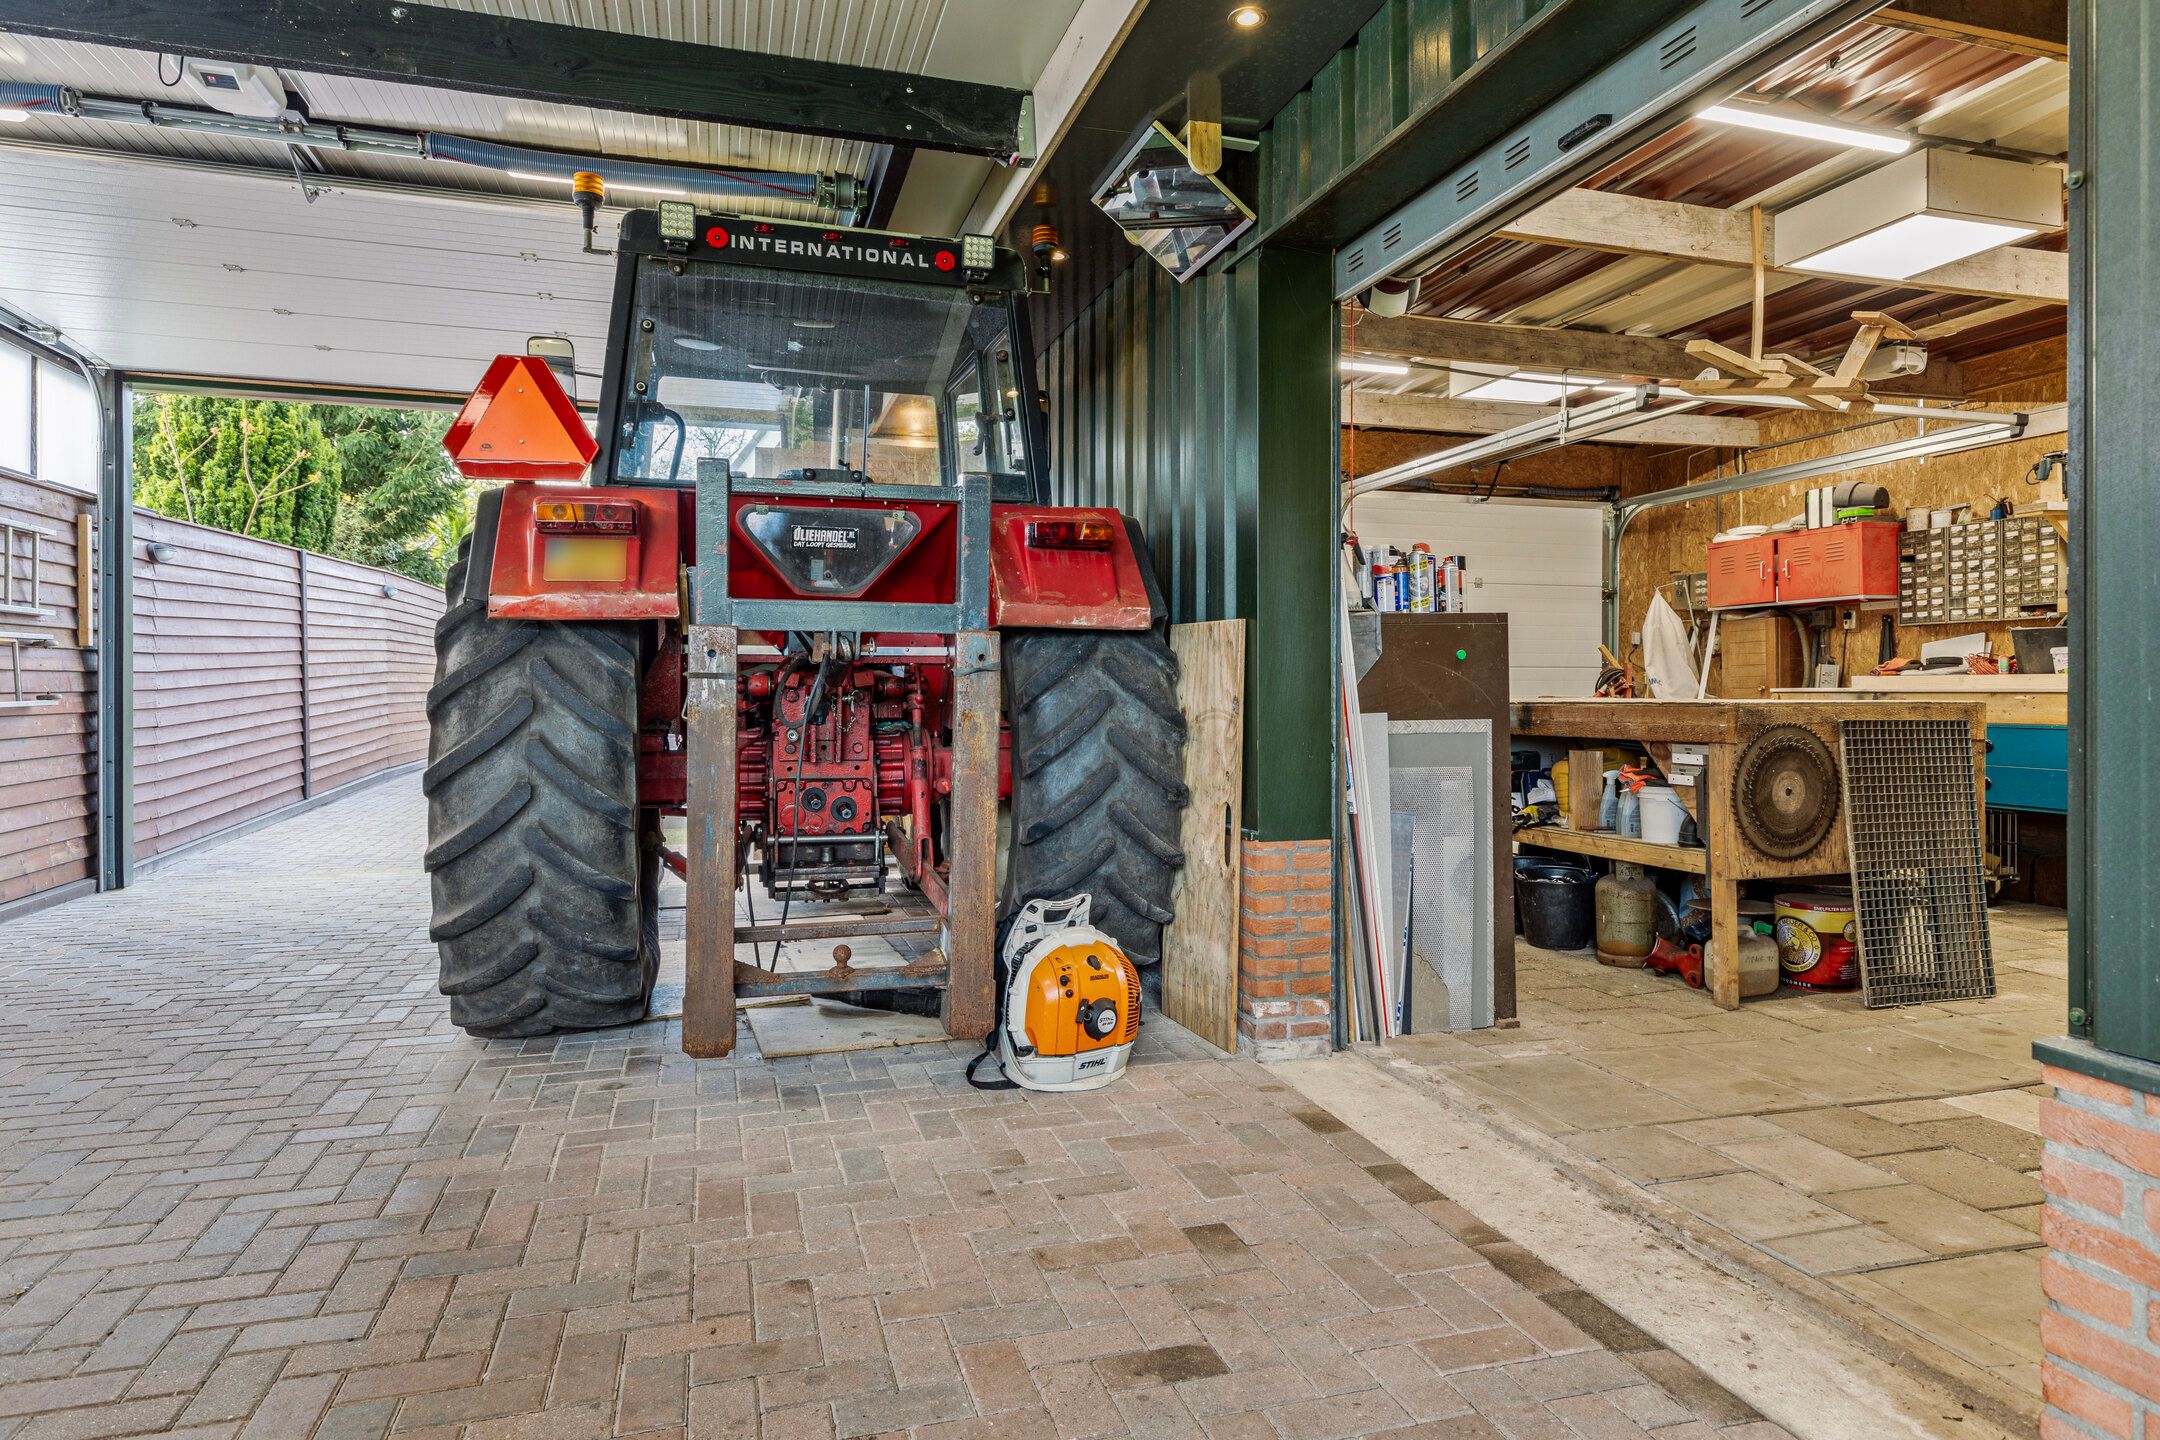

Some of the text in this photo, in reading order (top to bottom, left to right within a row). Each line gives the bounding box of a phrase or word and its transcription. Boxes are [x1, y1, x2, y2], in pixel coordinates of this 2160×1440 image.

[730, 234, 929, 268] INTERNATIONAL
[1099, 1015, 1114, 1024] STIHL
[1078, 1057, 1106, 1070] STIHL
